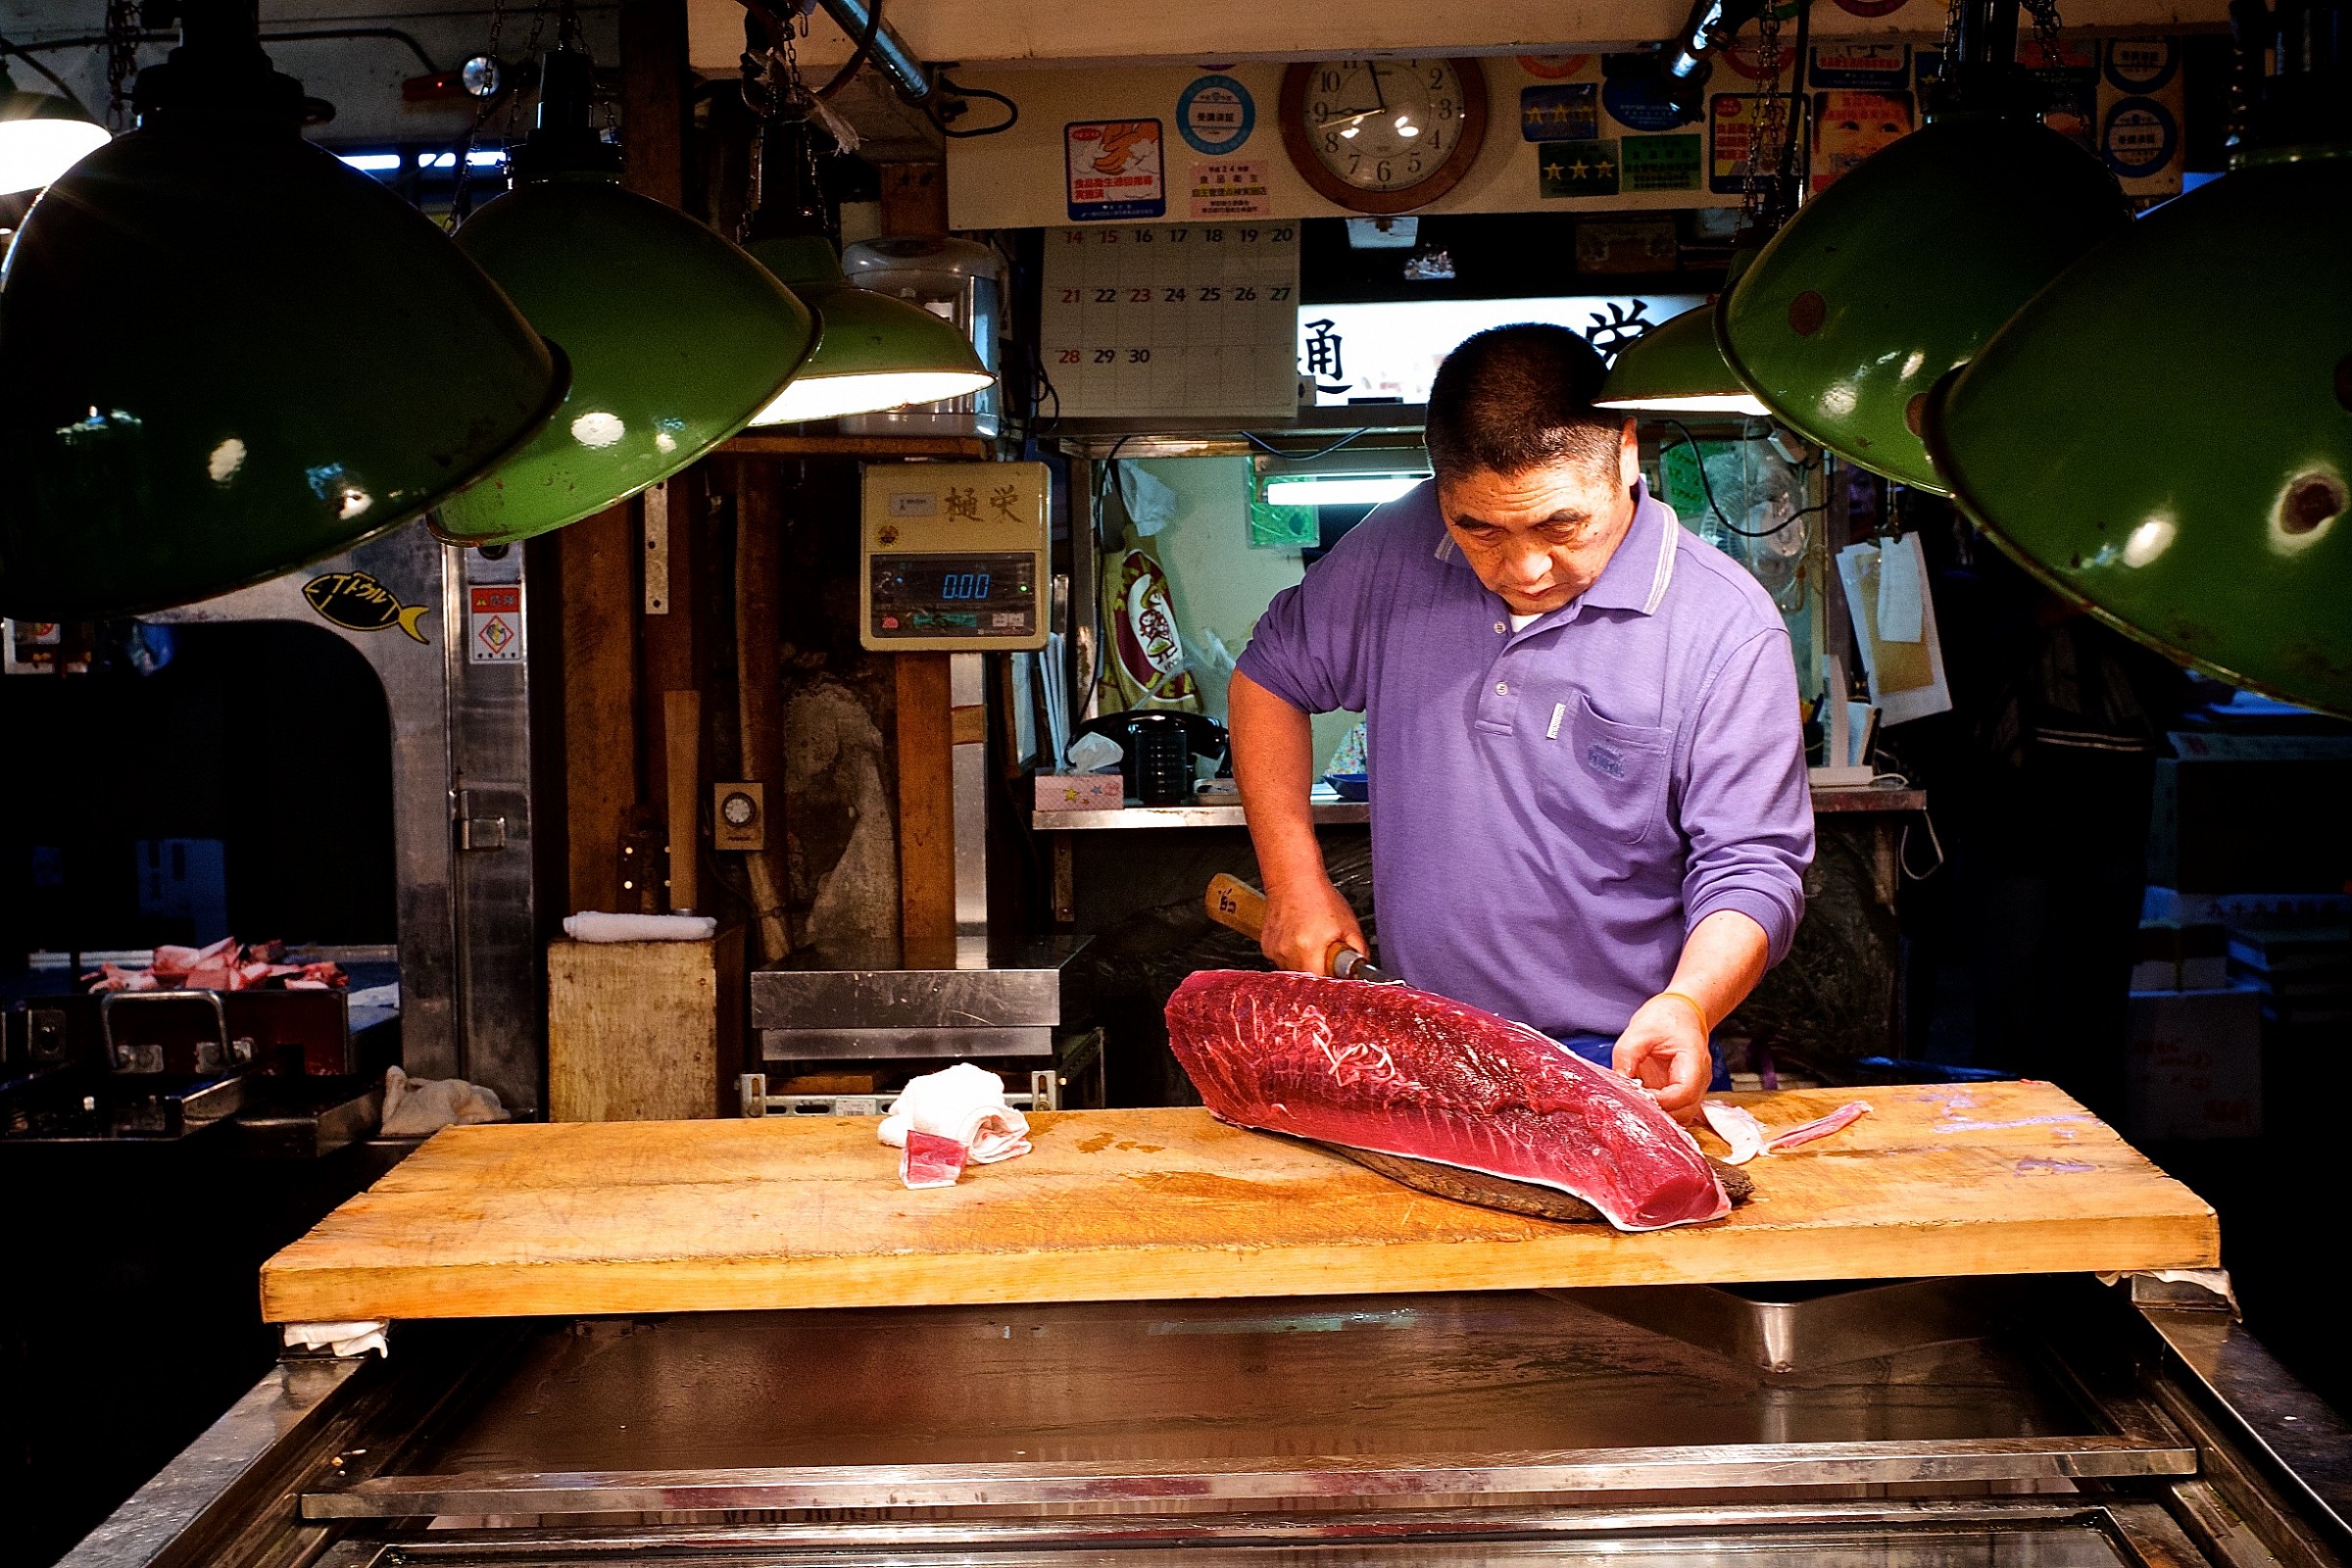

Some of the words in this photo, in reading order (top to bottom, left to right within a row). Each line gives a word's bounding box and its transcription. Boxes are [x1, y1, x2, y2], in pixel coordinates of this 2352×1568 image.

[1320, 71, 1341, 93] 10
[1430, 68, 1443, 90] 2
[1314, 101, 1329, 123] 9
[1439, 99, 1452, 120] 3
[1325, 131, 1339, 153] 8
[1428, 129, 1441, 149] 4
[1348, 154, 1361, 174] 7
[1376, 161, 1392, 182] 6
[1407, 151, 1422, 173] 5
[1065, 229, 1084, 244] 14
[1100, 229, 1118, 244] 15
[1135, 229, 1153, 243] 16
[1170, 228, 1189, 243] 17
[1204, 228, 1224, 242] 18
[1240, 228, 1258, 242] 19
[1271, 227, 1294, 242] 20
[1061, 289, 1081, 303] 21
[1095, 288, 1116, 303] 22
[1130, 288, 1152, 303] 23
[1164, 288, 1187, 302] 24
[1200, 287, 1221, 302] 25
[1235, 287, 1256, 301] 26
[1269, 287, 1292, 301] 27
[1058, 349, 1081, 364] 28
[1094, 349, 1115, 364] 29
[1129, 349, 1151, 364] 30
